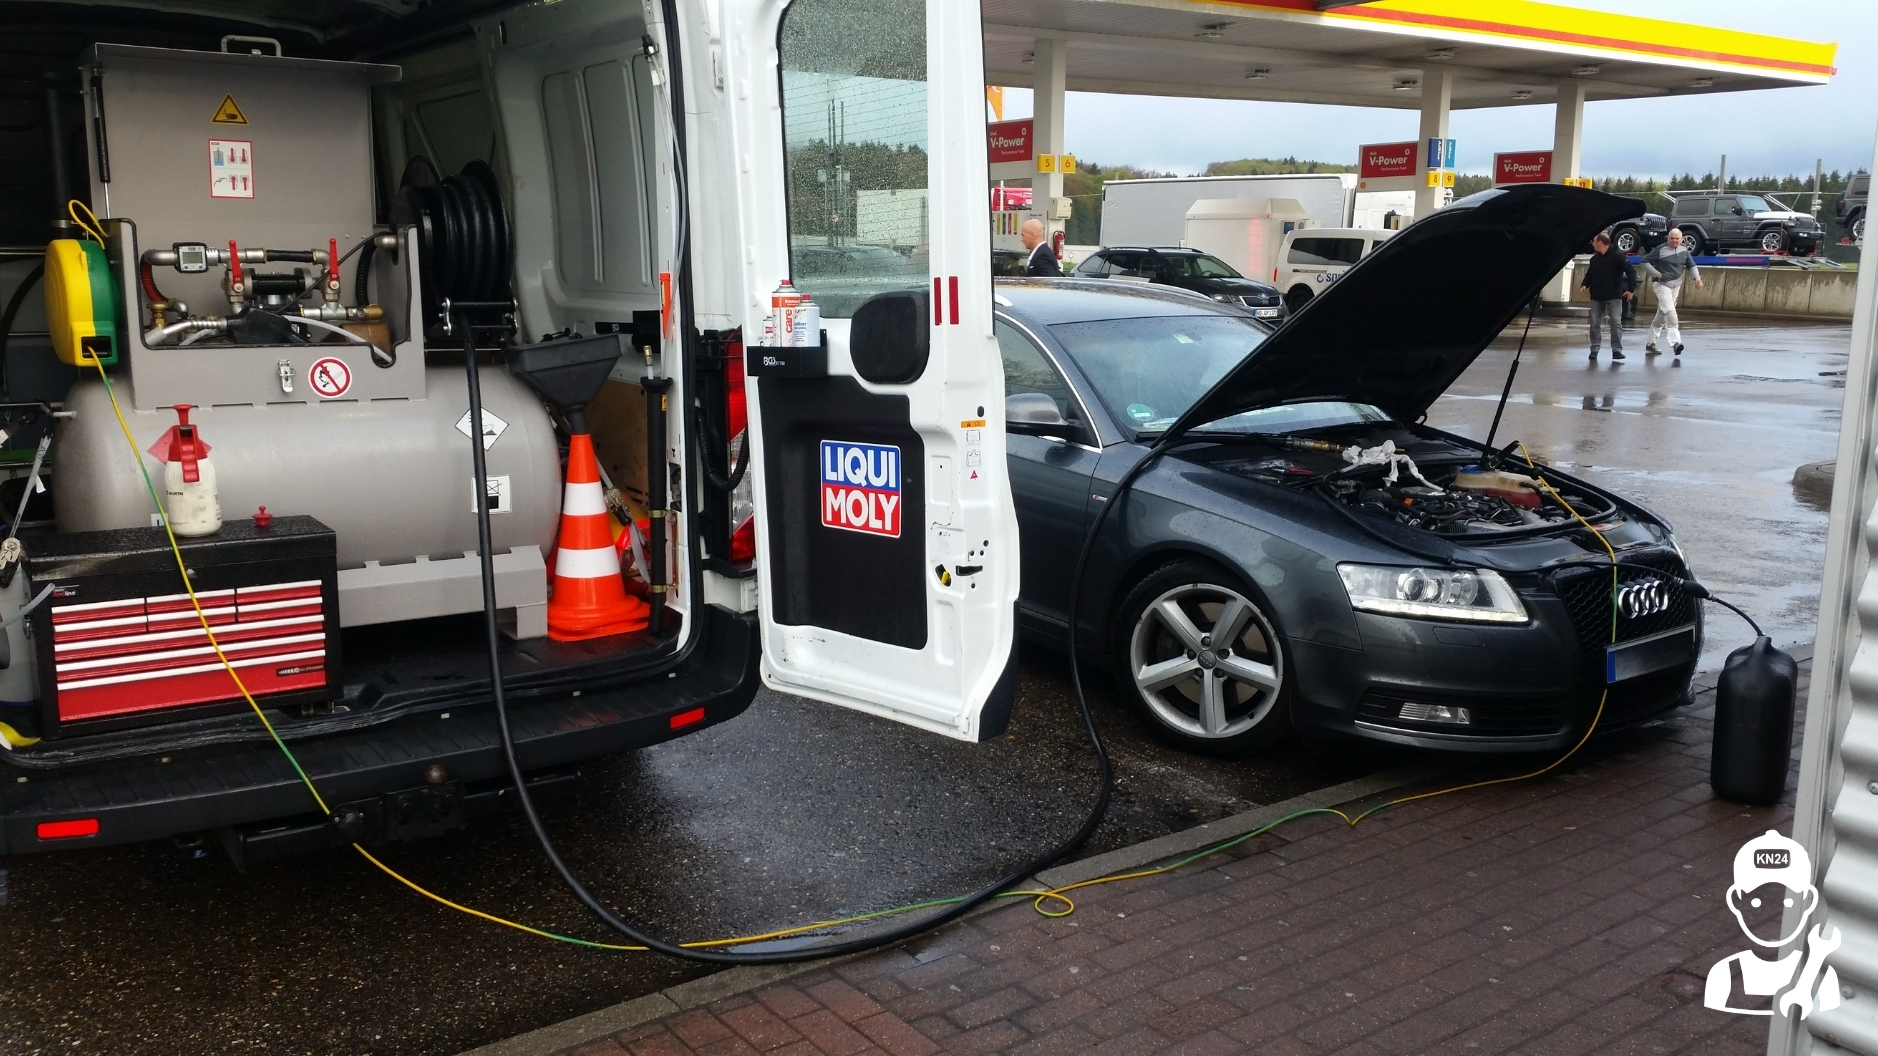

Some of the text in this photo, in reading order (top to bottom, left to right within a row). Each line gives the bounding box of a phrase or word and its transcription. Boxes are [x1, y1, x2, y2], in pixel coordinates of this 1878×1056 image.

[990, 137, 1025, 148] V-Power
[1045, 159, 1050, 167] 5
[1065, 159, 1071, 167] 6
[1369, 155, 1408, 166] V-Power
[1504, 163, 1542, 172] V-Power
[785, 308, 793, 333] care
[824, 445, 897, 488] LIQUI
[825, 487, 899, 531] MOLY
